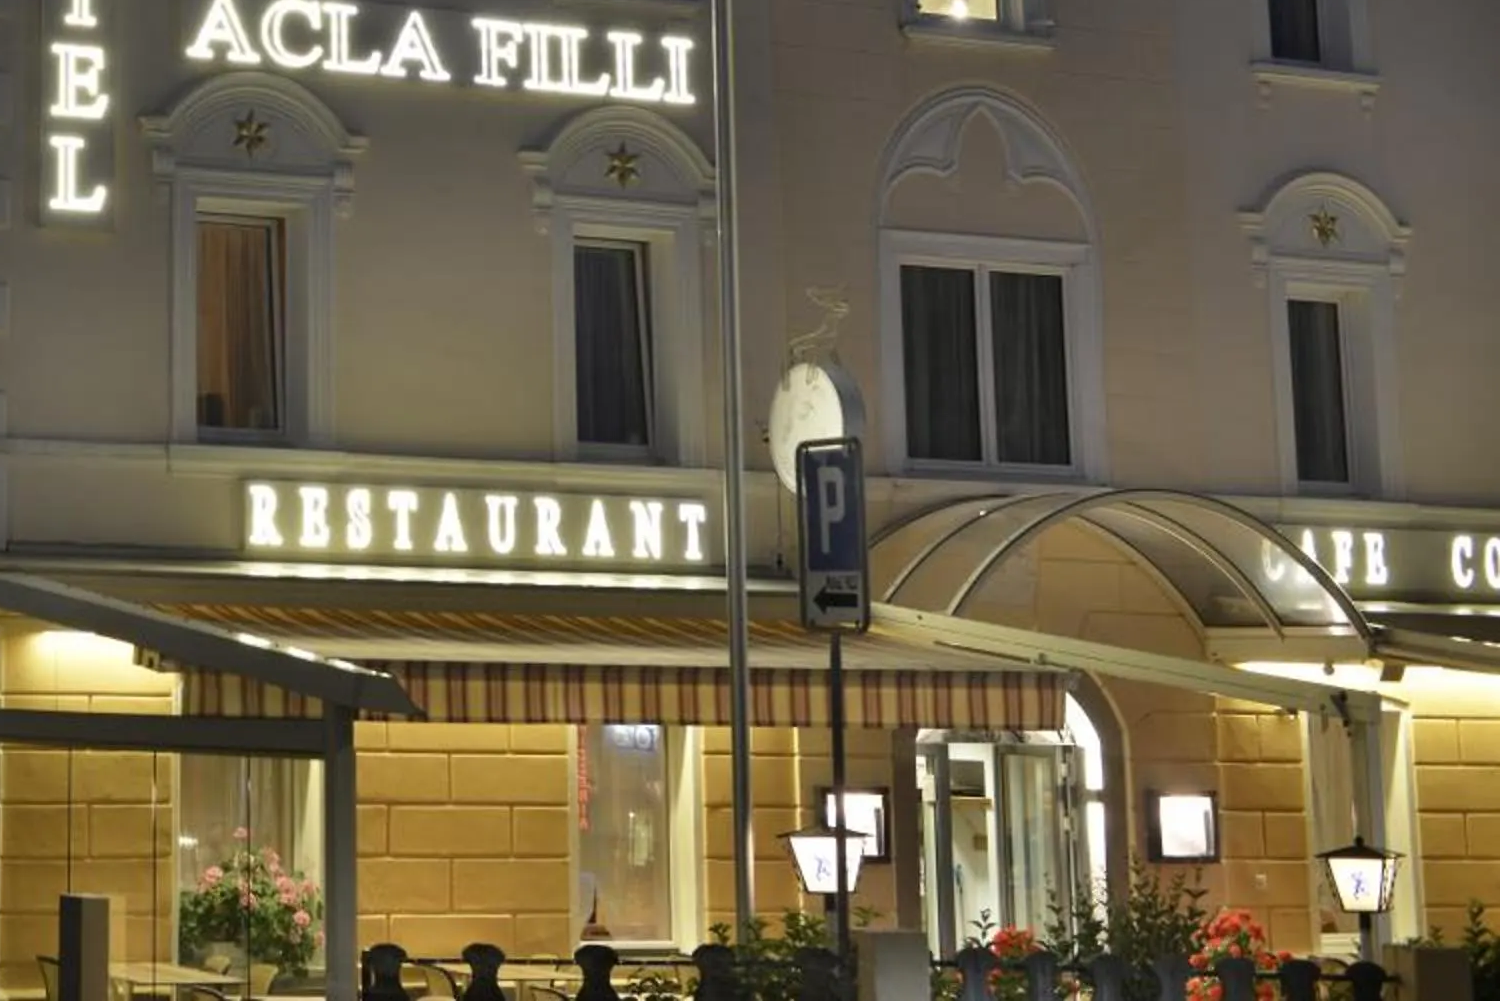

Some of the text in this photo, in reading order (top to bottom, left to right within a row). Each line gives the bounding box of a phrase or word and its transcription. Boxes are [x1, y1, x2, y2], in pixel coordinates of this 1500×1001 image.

[471, 16, 696, 103] FILLI
[248, 483, 708, 560] RESTAURANT
[817, 466, 845, 554] P
